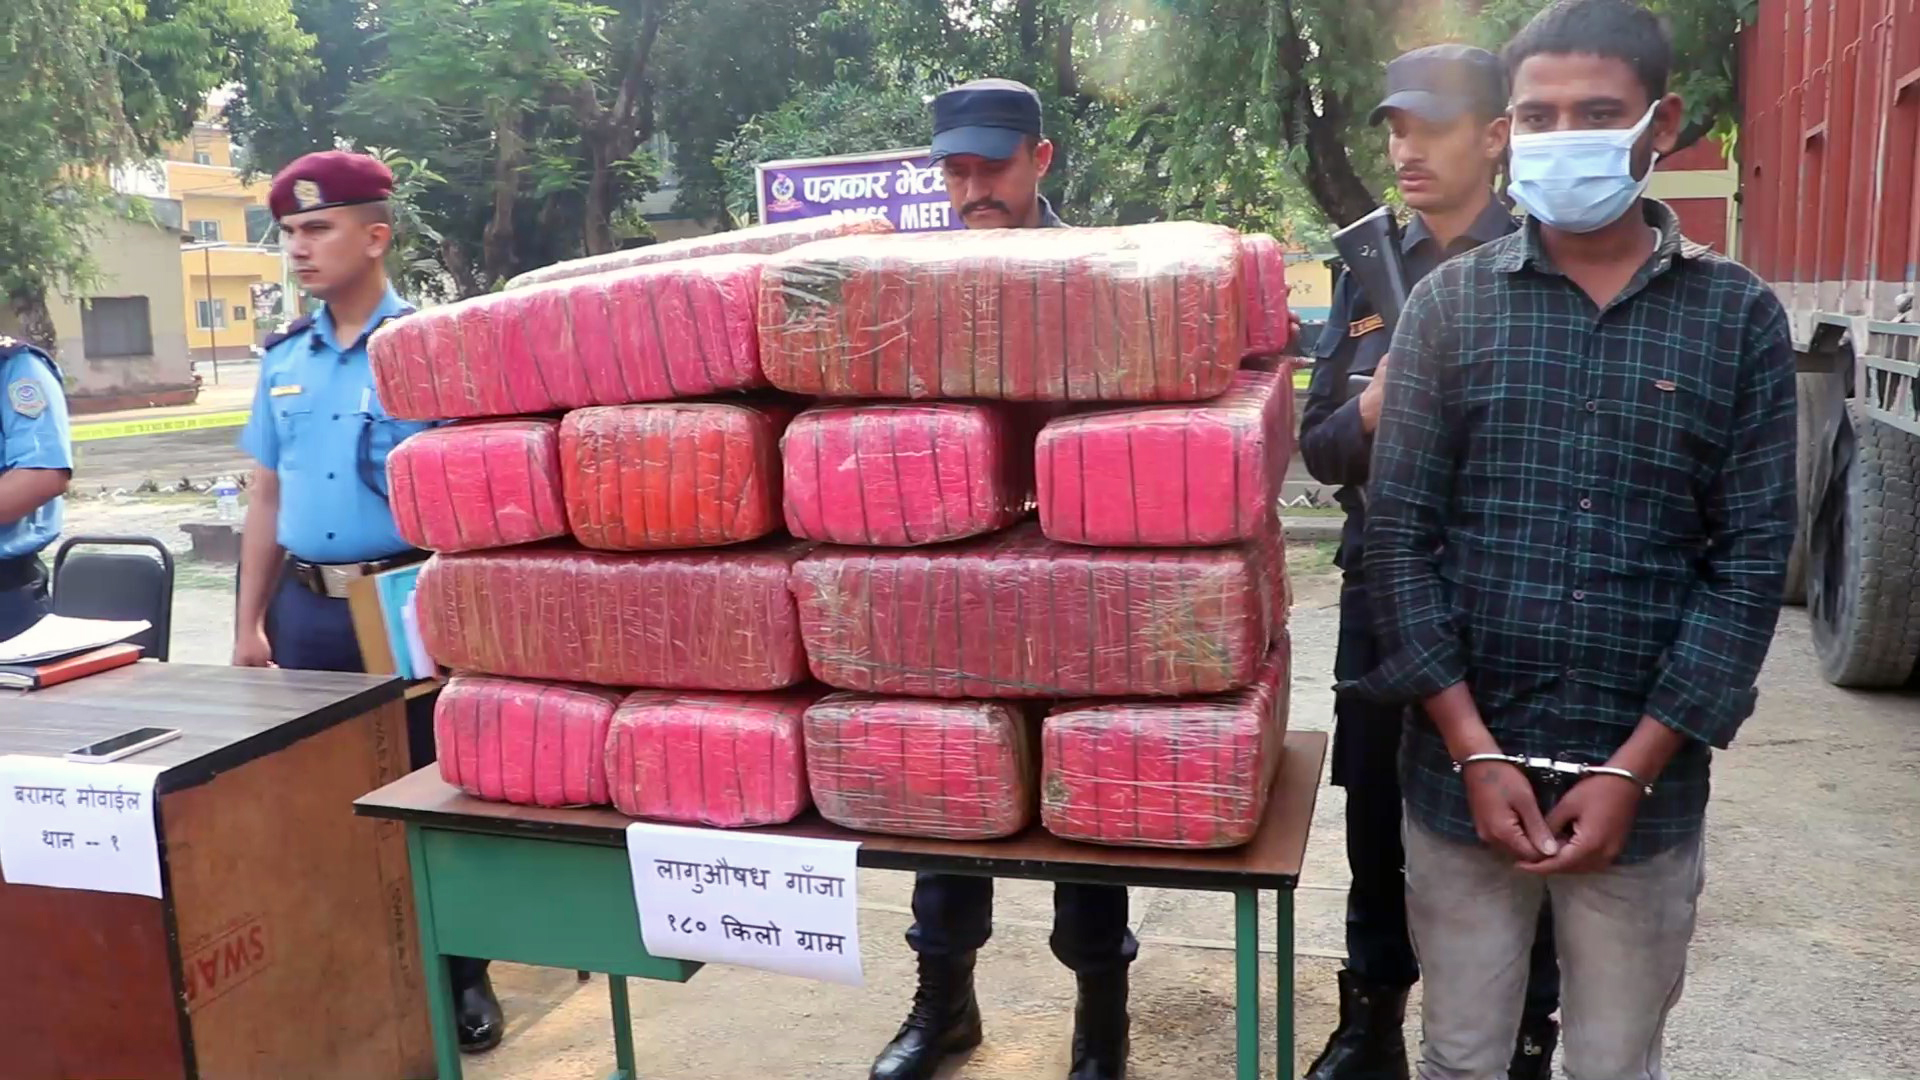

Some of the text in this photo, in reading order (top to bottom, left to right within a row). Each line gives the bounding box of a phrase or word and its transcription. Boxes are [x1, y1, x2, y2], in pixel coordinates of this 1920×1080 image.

[803, 172, 891, 203] पत्रकार
[900, 201, 951, 230] MEET
[42, 830, 75, 849] थान
[111, 834, 120, 851] १
[654, 857, 845, 898] लागुऔषध गाँजा
[667, 913, 846, 954] १८० किलो ग्राम
